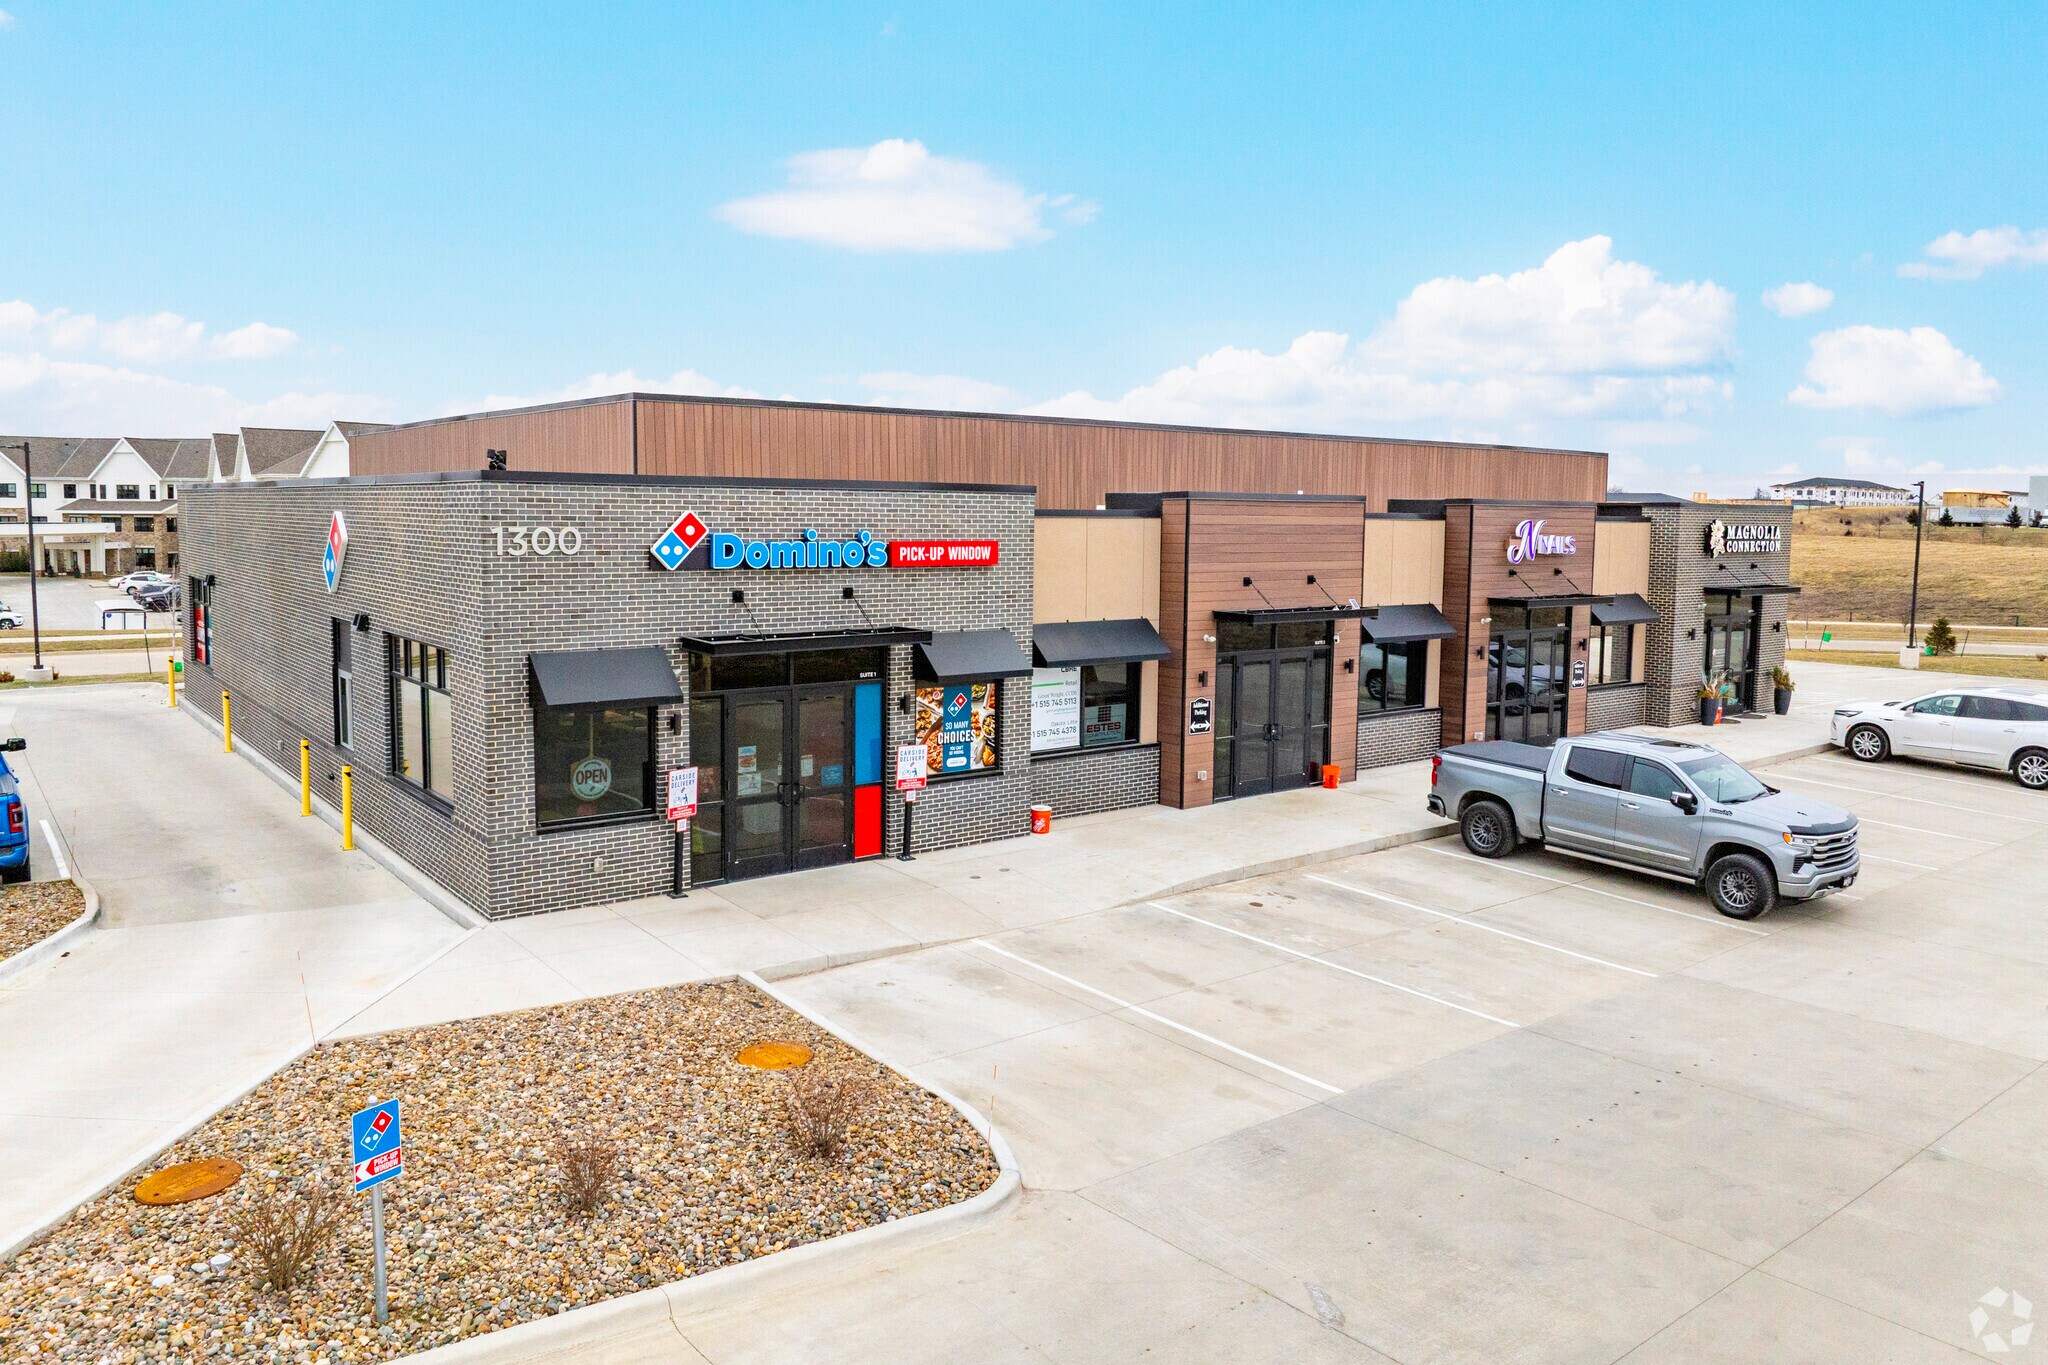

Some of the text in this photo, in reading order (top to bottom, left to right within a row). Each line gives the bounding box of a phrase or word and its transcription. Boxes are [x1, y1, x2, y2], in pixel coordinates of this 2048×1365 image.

[1727, 525, 1780, 539] MAGNOLIA
[491, 526, 582, 556] 1300
[1726, 540, 1780, 552] CONNECTION
[710, 528, 888, 569] Domino's
[900, 546, 991, 561] PICK-UP WINDOW
[1040, 700, 1050, 708] 515
[1051, 698, 1063, 706] 745
[1064, 697, 1077, 705] 5113
[945, 720, 969, 730] SO MANY
[1086, 722, 1121, 733] ESTES
[938, 730, 976, 744] CHOICES
[1036, 730, 1047, 738] 515
[1049, 728, 1060, 736] 745
[1061, 726, 1077, 734] 4378
[900, 749, 925, 757] CARSIDE
[576, 768, 607, 785] OPEN
[671, 772, 695, 782] CARSIDE
[671, 779, 695, 789] DELIVERY
[374, 1151, 398, 1167] PICK-UP
[374, 1157, 398, 1174] WINDOW
